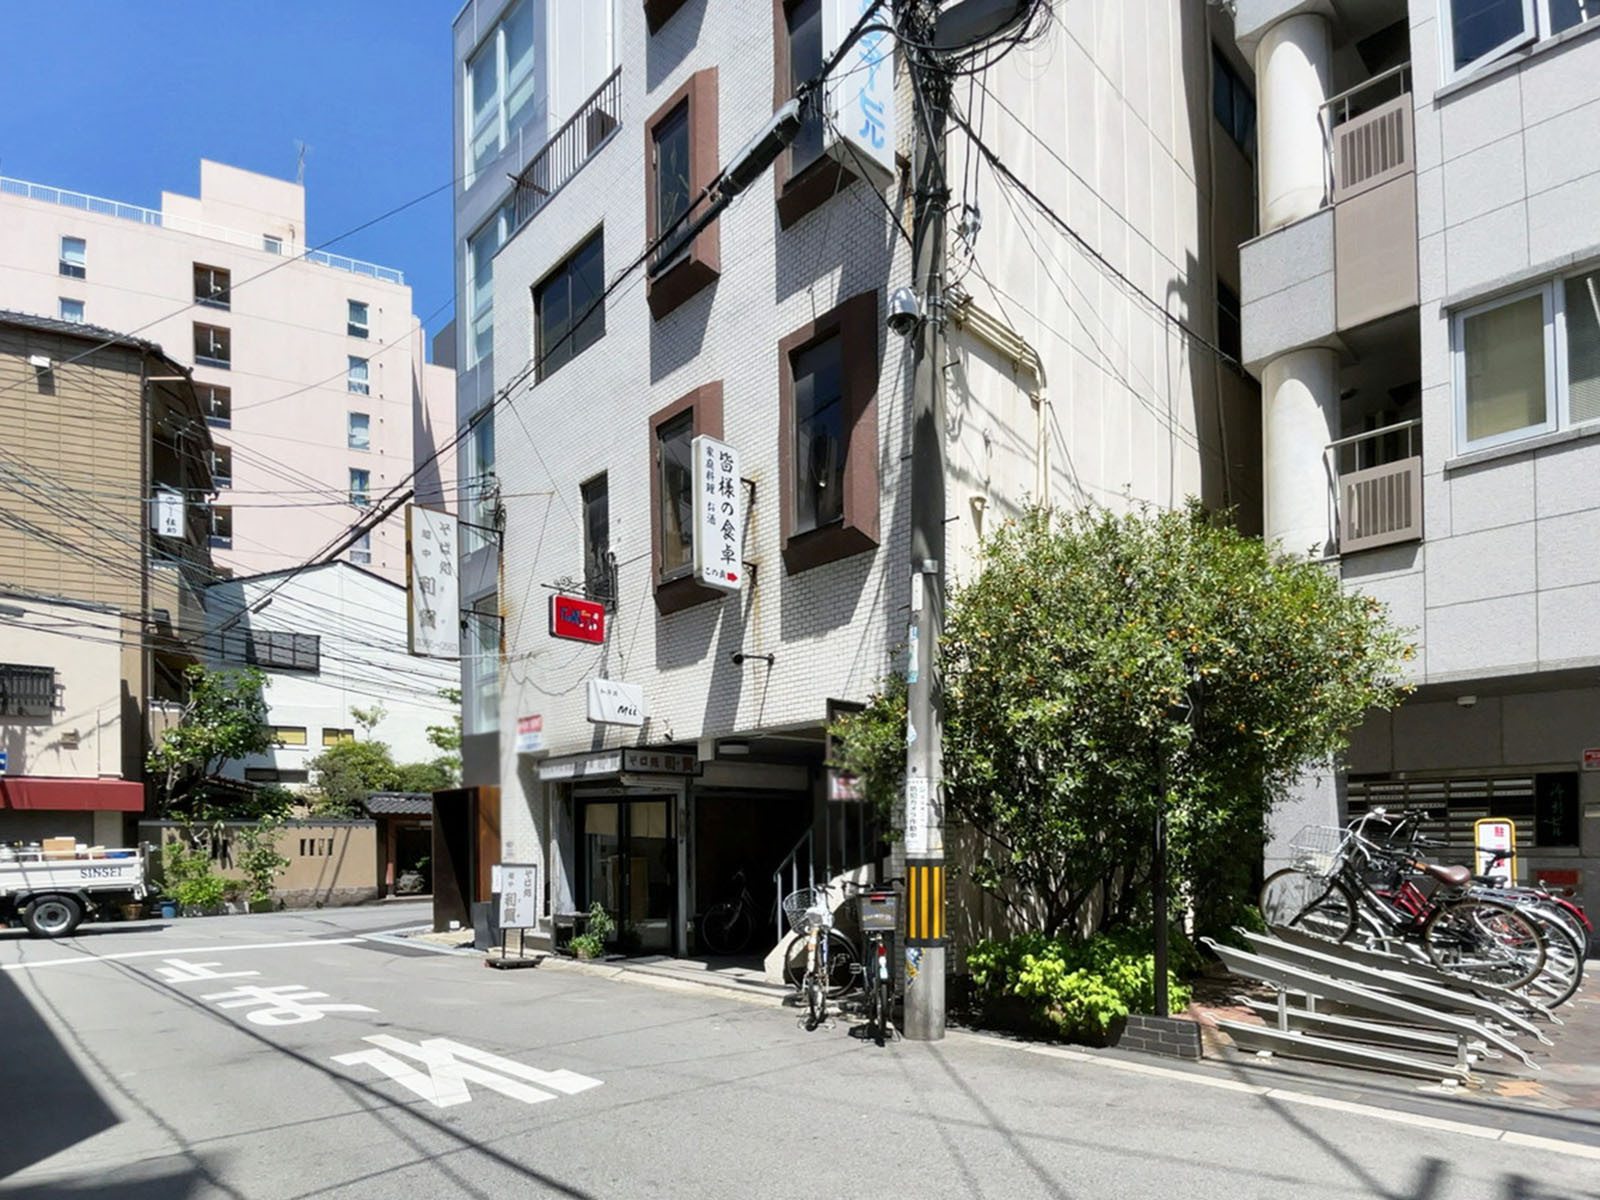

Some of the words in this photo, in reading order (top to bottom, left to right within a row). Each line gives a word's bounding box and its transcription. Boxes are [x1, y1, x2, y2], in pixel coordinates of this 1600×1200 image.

[719, 450, 737, 565] 皆様の食卓
[80, 867, 122, 879] SINSEI
[154, 958, 604, 1107] 止まれ
